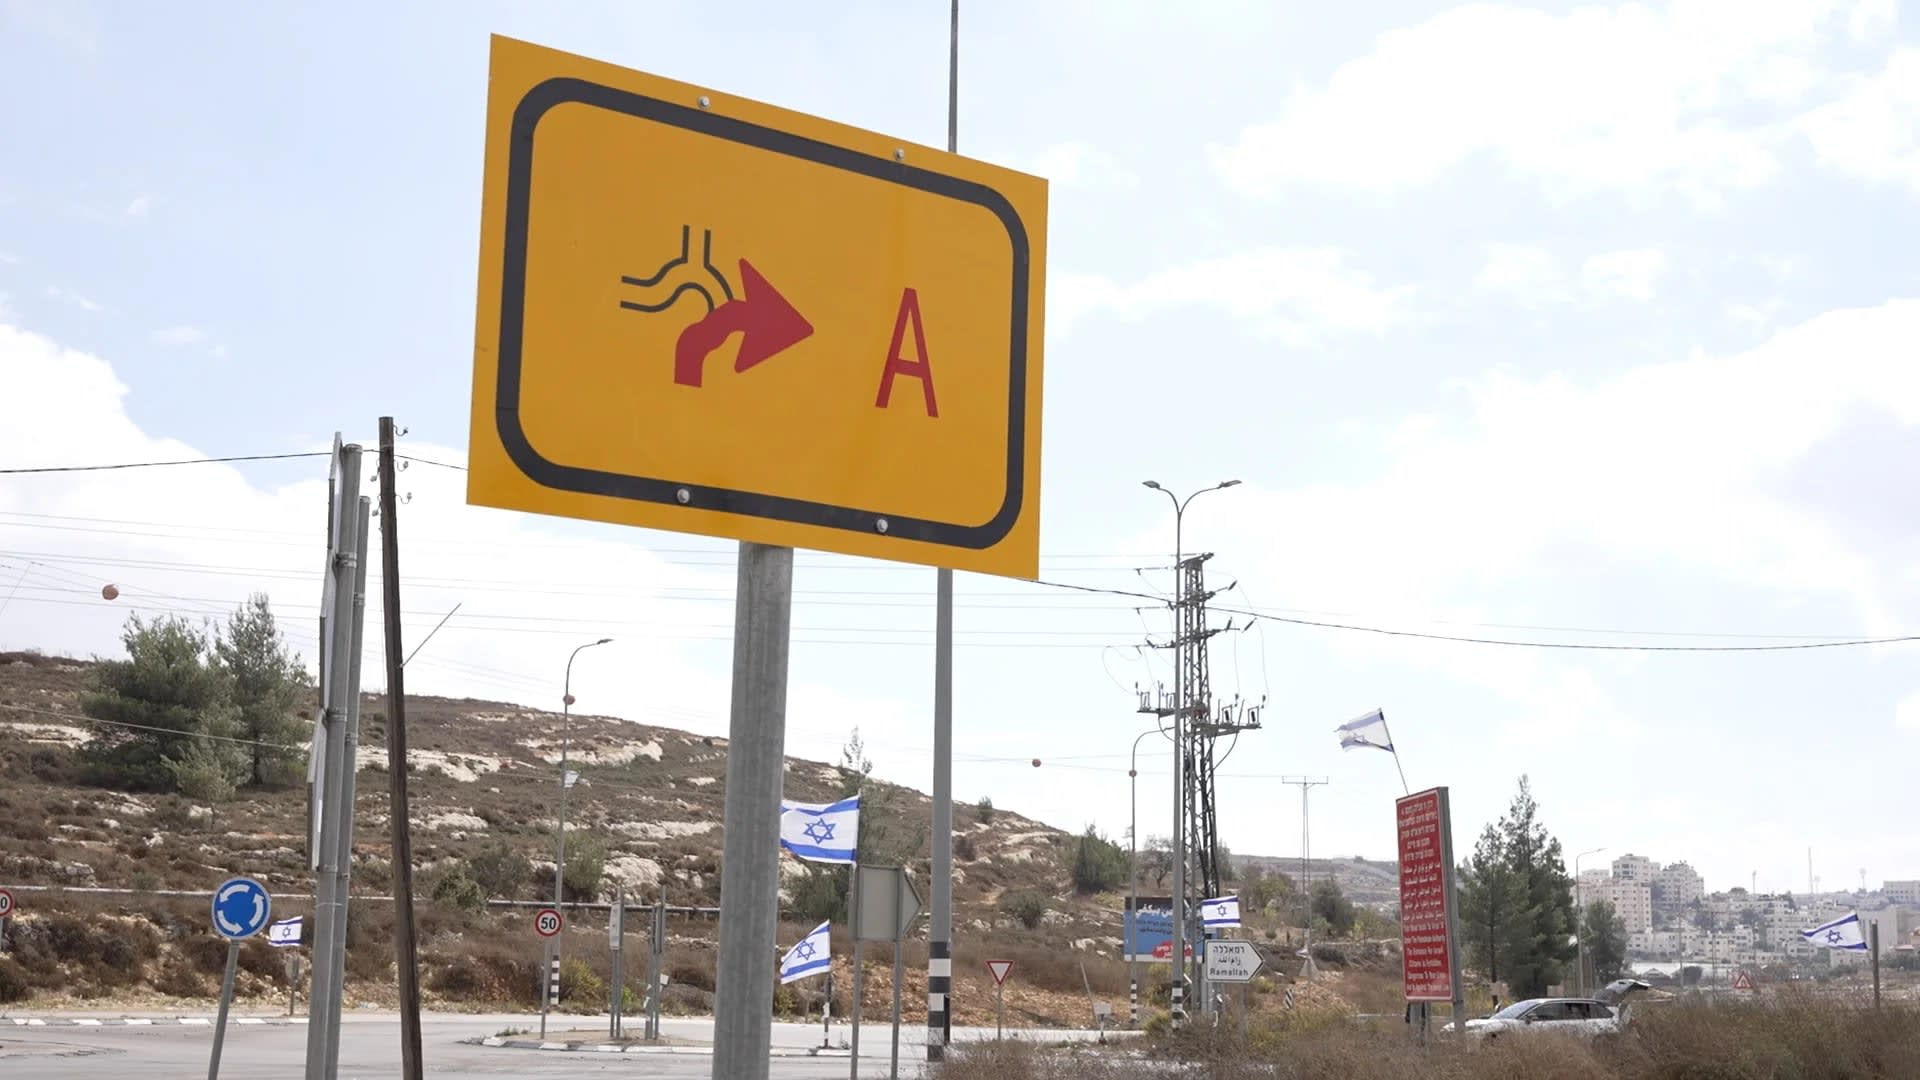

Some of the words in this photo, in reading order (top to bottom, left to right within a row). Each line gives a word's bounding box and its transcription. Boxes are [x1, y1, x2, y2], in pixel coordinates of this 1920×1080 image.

[875, 287, 939, 418] A
[0, 896, 8, 909] 0
[541, 916, 557, 930] 50
[1212, 945, 1245, 954] רמאללה
[1209, 967, 1249, 976] Ramallah
